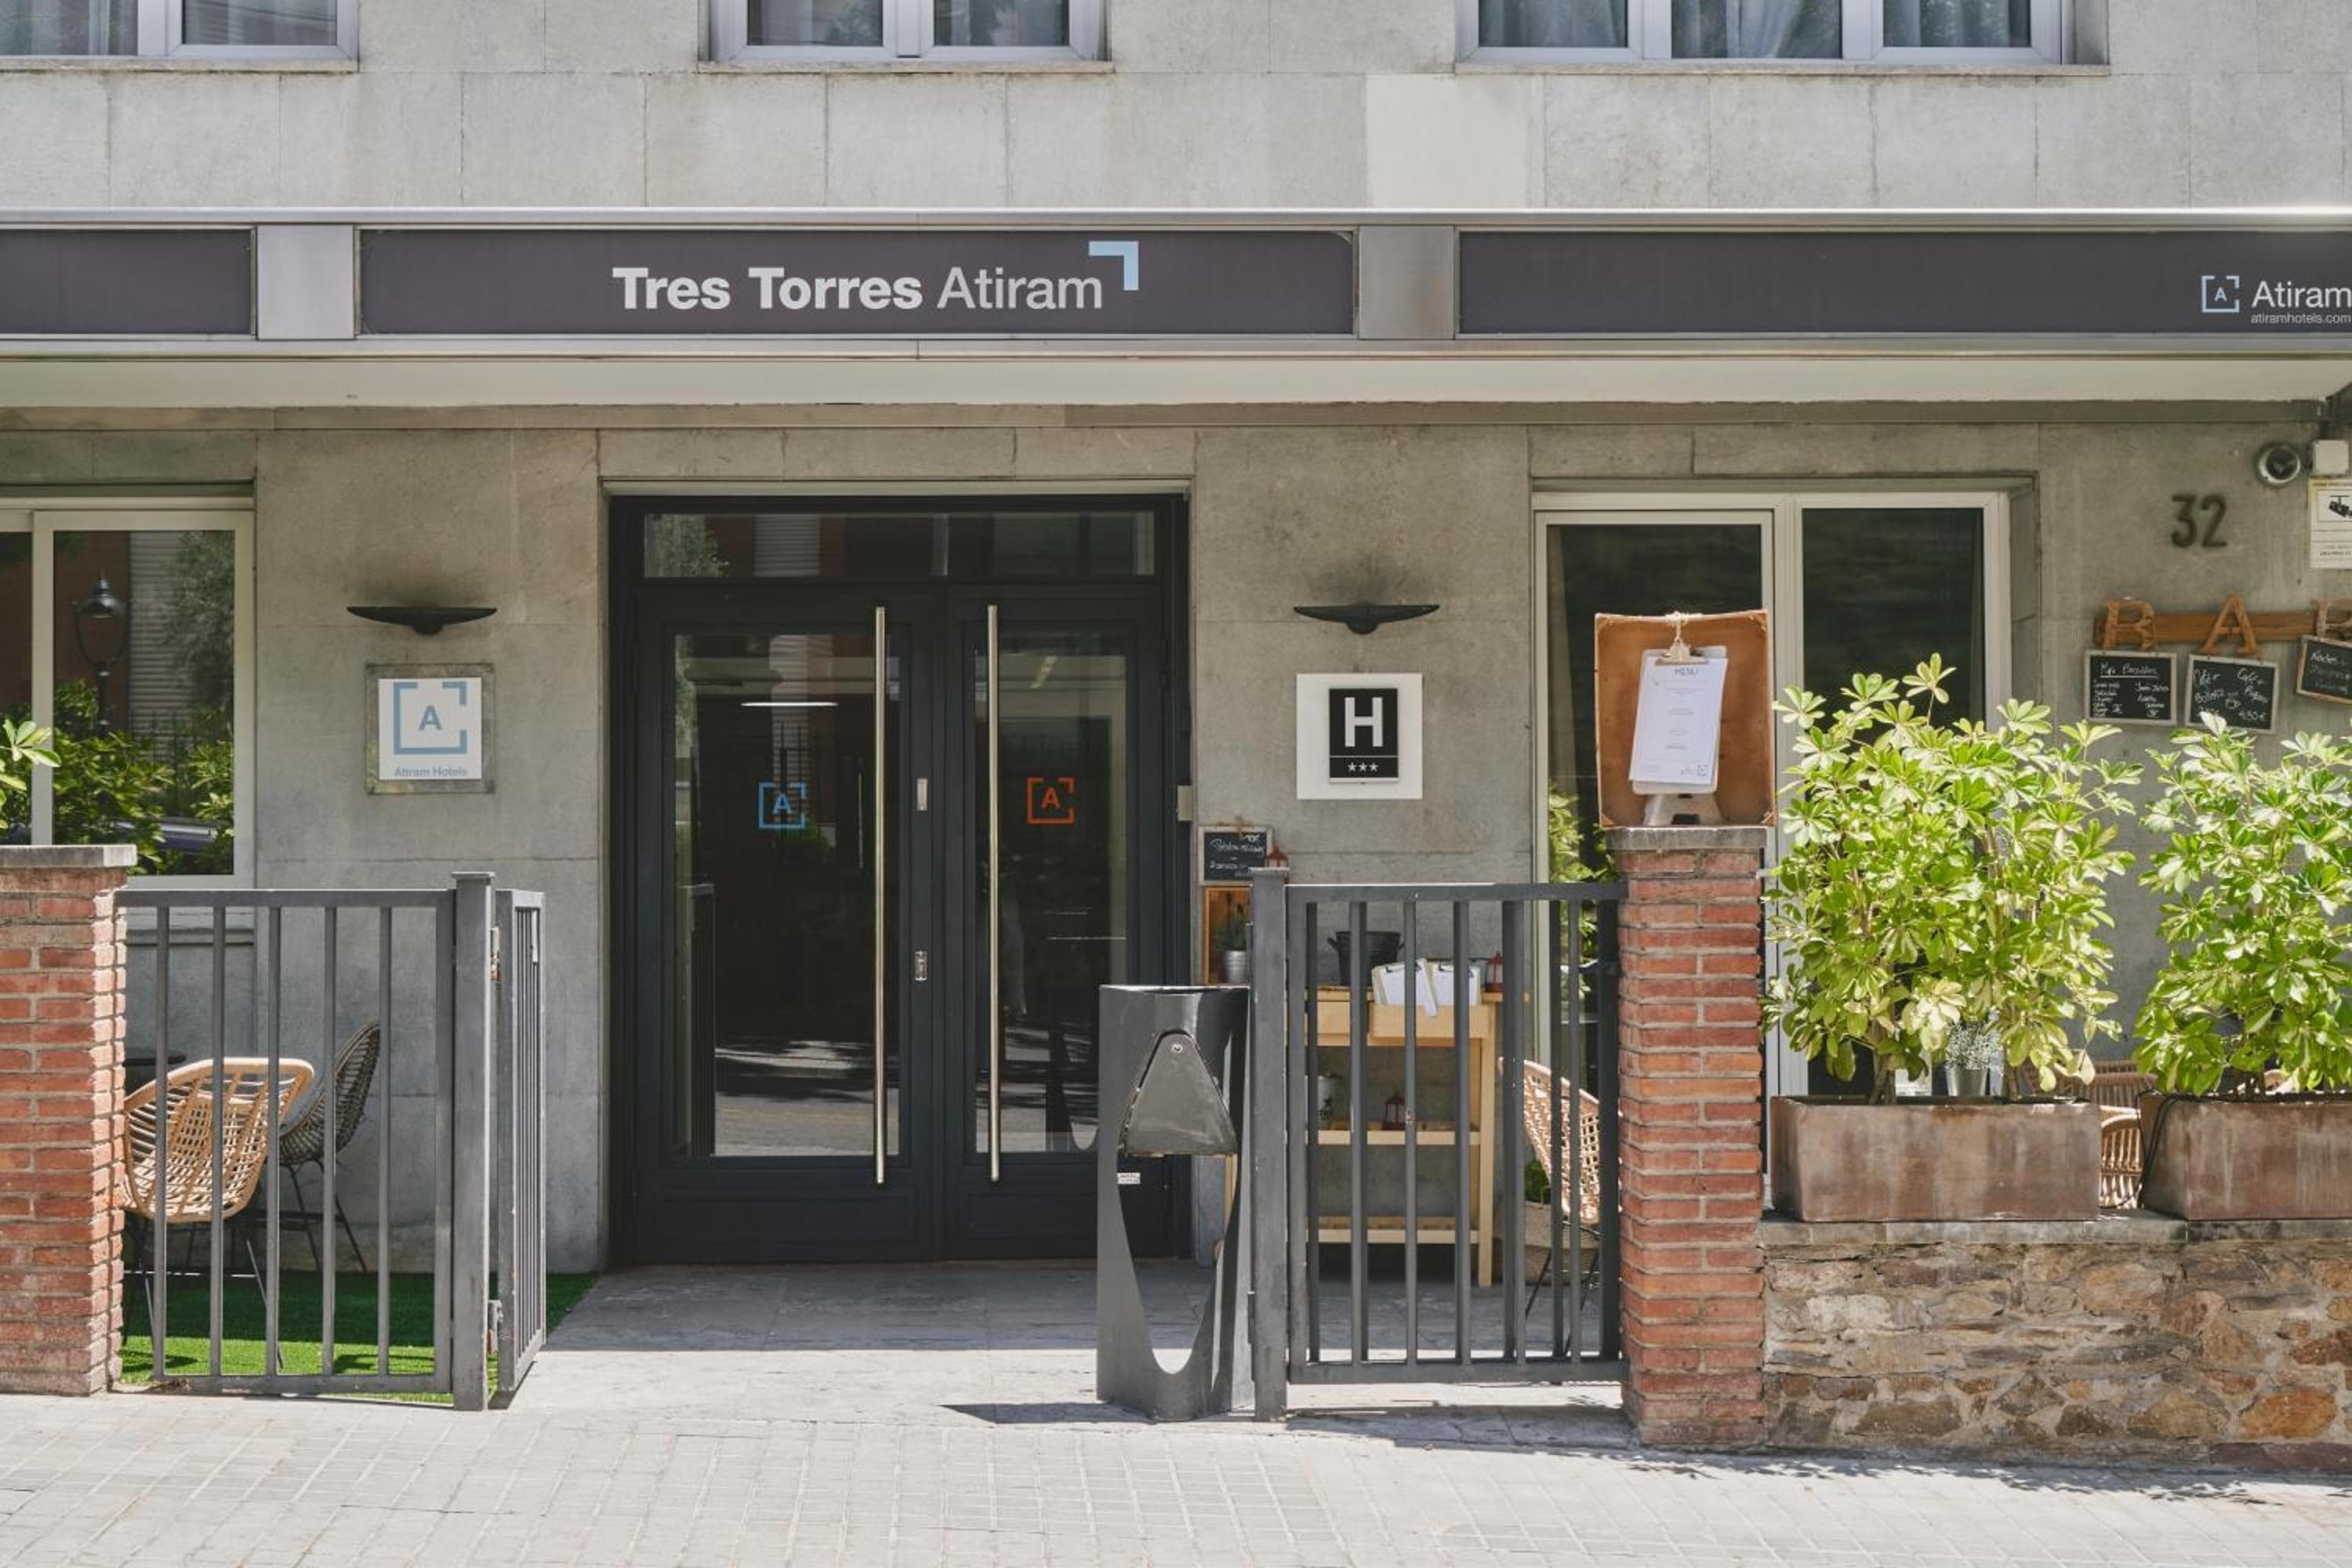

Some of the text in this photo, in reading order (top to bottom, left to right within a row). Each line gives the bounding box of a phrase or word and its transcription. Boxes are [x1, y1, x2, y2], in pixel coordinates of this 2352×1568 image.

[612, 267, 1103, 310] Tres Torres Atiram
[2214, 287, 2227, 301] A
[2252, 281, 2352, 308] Atiram
[2251, 313, 2352, 324] atiramhotels.com
[2171, 494, 2228, 548] 32
[419, 705, 442, 730] A
[1345, 697, 1383, 747] H
[394, 764, 467, 777] Atiram Hotels
[772, 792, 791, 814] A
[1041, 786, 1061, 808] A
